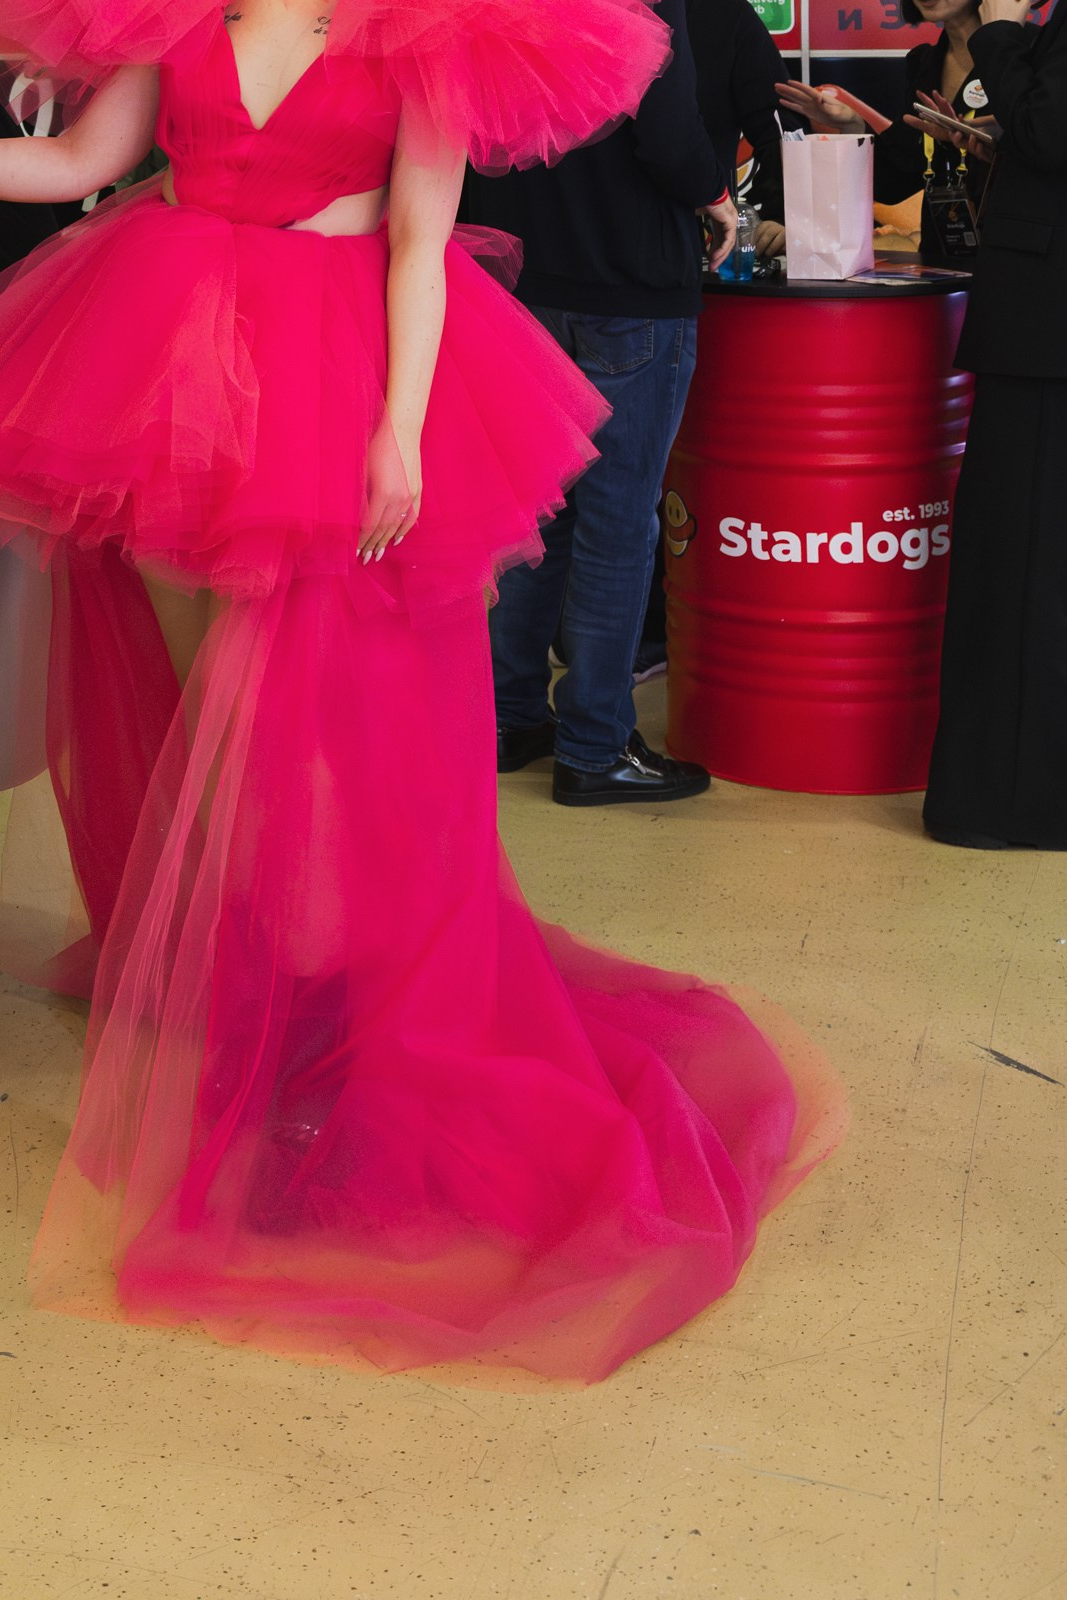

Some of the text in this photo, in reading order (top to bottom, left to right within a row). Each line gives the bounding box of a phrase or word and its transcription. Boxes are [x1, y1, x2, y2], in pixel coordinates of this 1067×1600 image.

[882, 500, 950, 522] est. 1993
[718, 516, 951, 570] Stardogs
